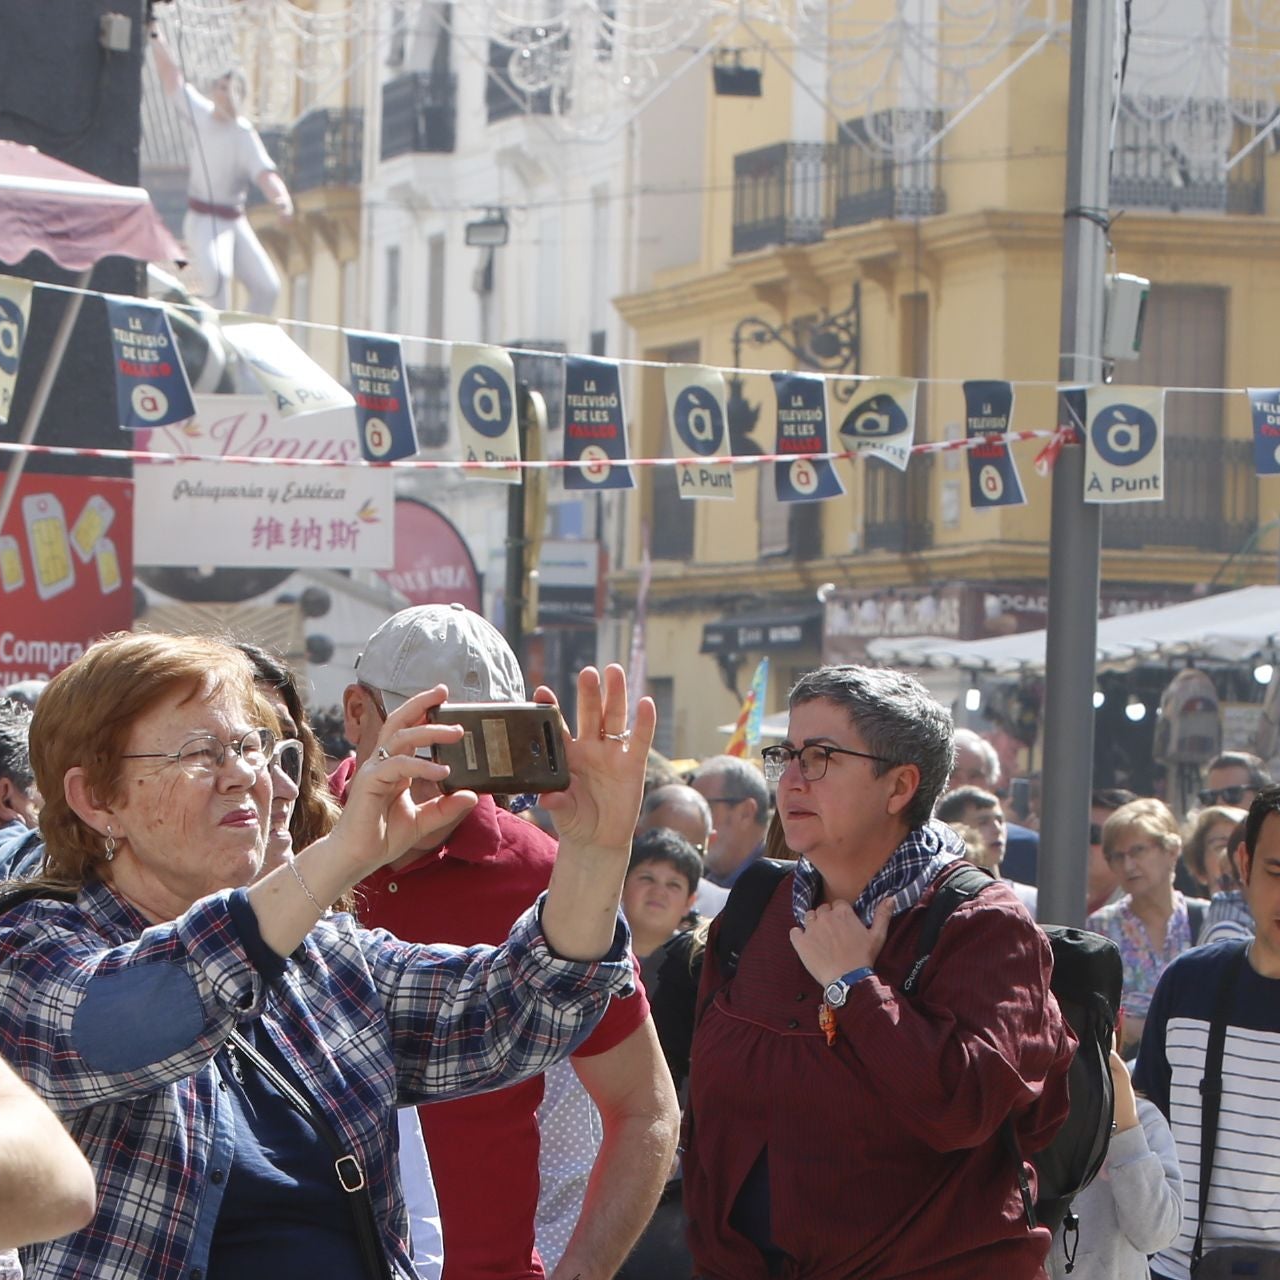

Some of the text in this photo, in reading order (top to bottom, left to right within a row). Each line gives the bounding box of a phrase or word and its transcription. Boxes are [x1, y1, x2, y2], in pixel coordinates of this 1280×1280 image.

[128, 317, 142, 330] LA
[113, 327, 168, 347] TELEVISIÓ
[365, 351, 378, 364] LA
[351, 361, 400, 380] TELEVISIÓ
[358, 378, 391, 394] DE LES
[583, 379, 596, 393] LA
[567, 392, 618, 408] TELEVISIÓ
[791, 395, 803, 407] LA
[573, 408, 609, 423] DE LES
[778, 406, 823, 422] TELEVISIÓ
[209, 411, 357, 462] Venus
[783, 423, 816, 436] DE LES
[700, 468, 732, 489] Punt
[1087, 472, 1160, 493] À Punt
[251, 516, 360, 551] 维纳斯
